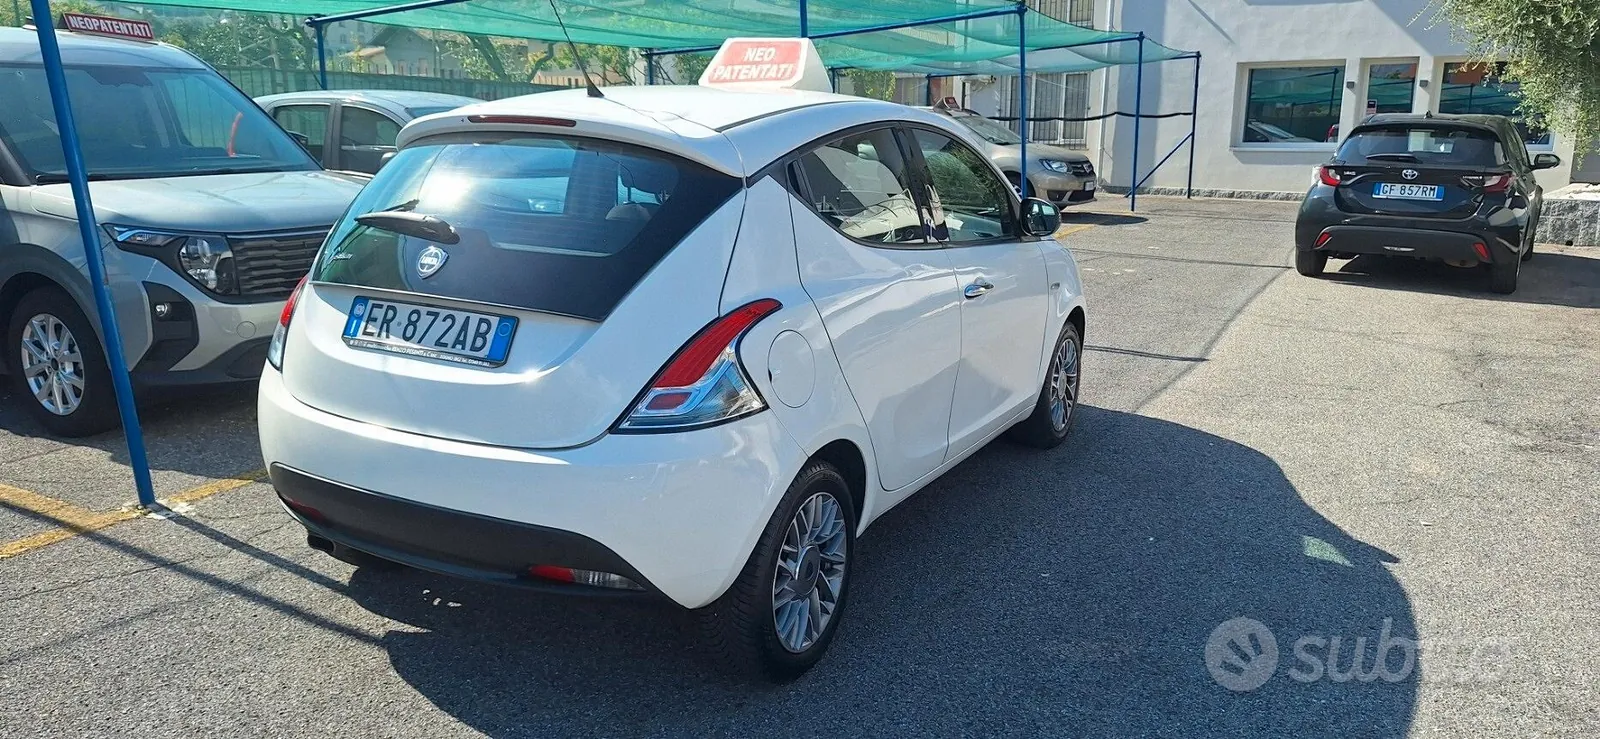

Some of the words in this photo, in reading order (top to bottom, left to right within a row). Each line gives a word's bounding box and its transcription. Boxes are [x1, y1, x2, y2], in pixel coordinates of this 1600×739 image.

[68, 15, 152, 37] NEOPATENTATI
[743, 46, 777, 62] NEO
[712, 63, 794, 80] PATENTATI
[1382, 184, 1396, 195] GF
[1399, 185, 1437, 197] 857RM
[362, 302, 398, 339] ER
[402, 308, 493, 353] 872AB
